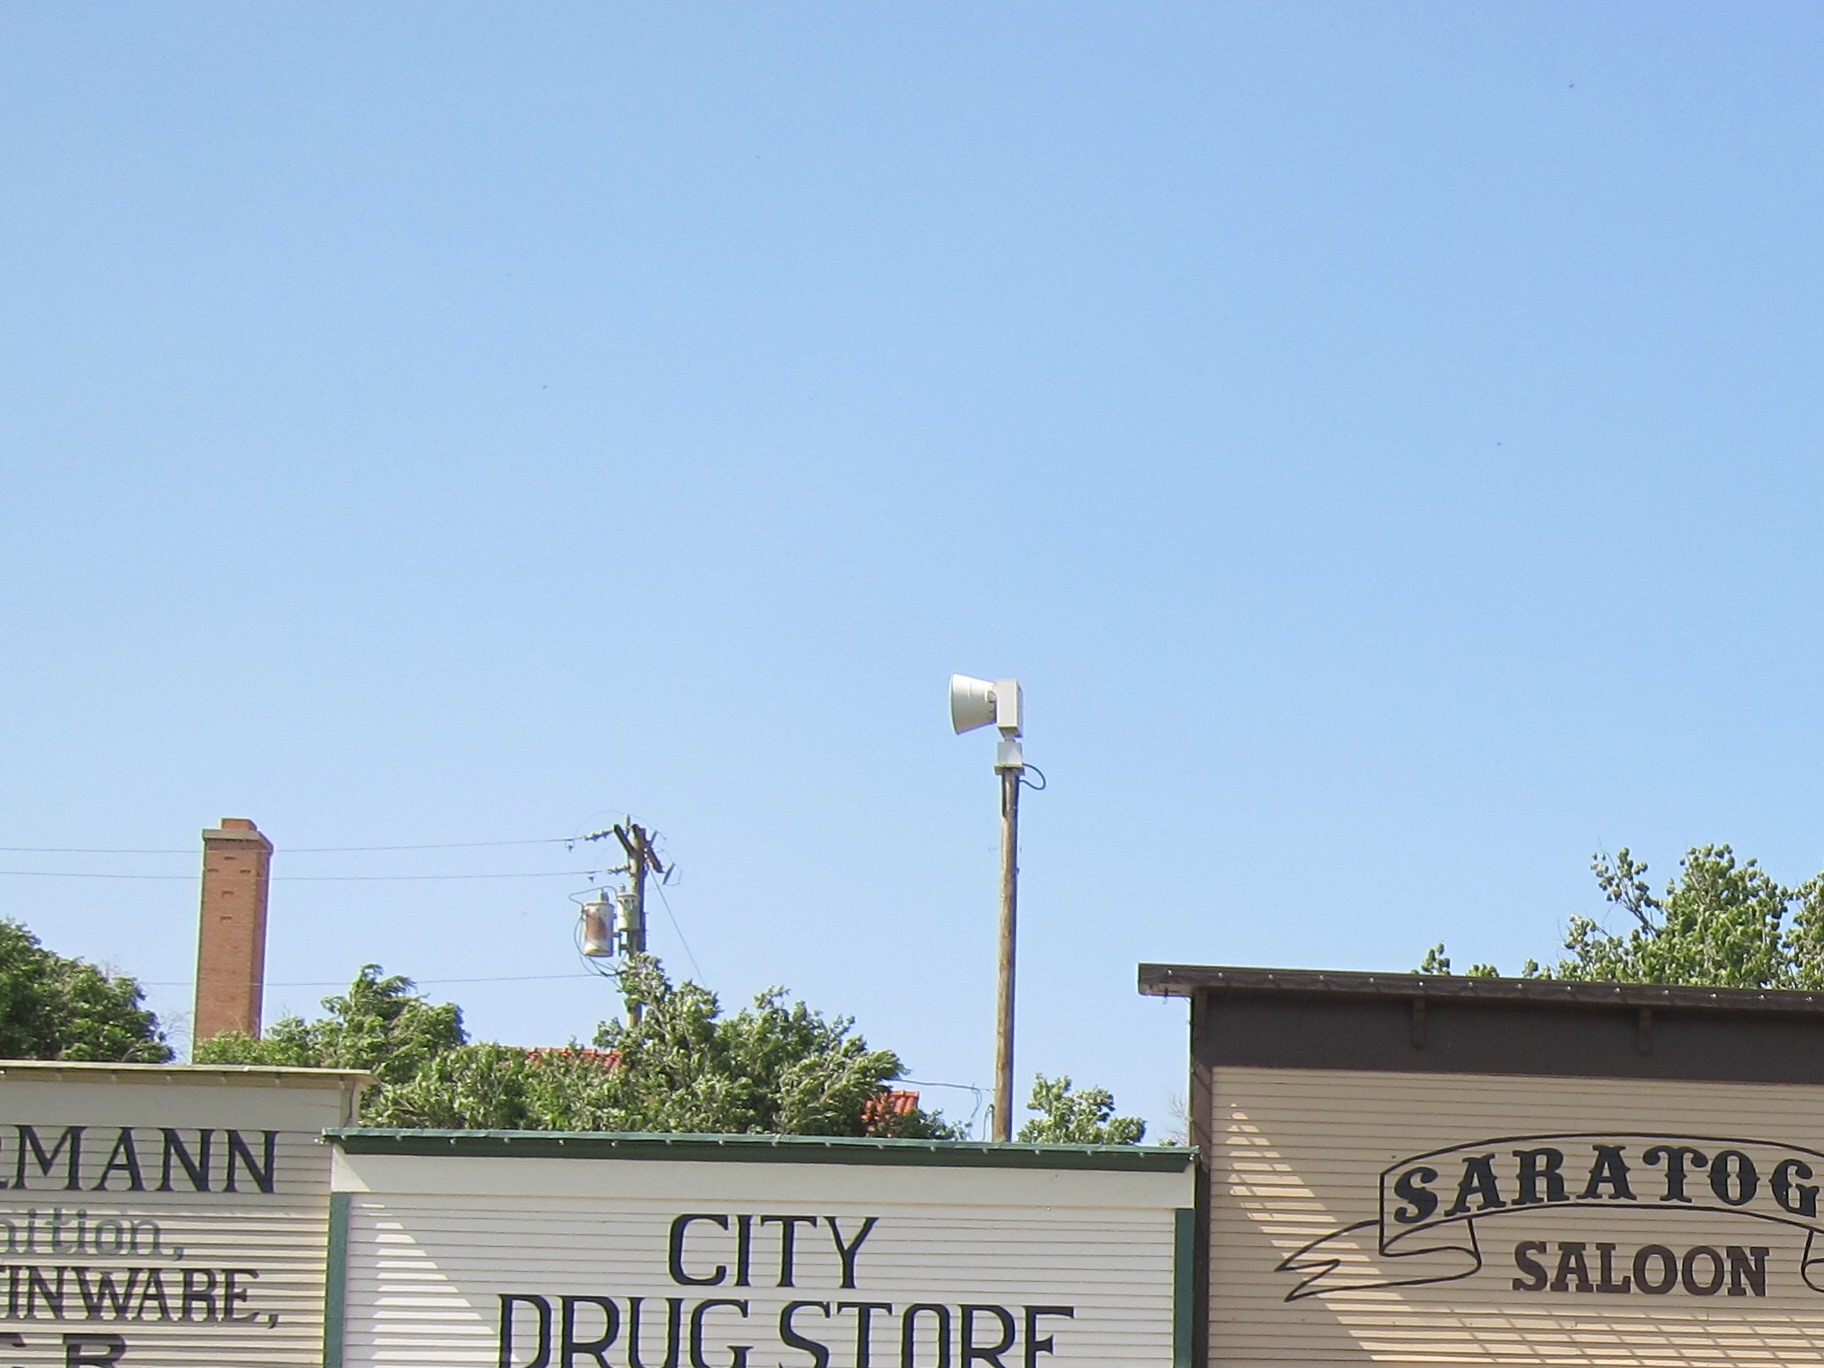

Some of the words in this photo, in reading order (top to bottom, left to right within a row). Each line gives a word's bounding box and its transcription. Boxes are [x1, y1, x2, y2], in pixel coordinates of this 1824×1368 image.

[0, 1124, 281, 1194] MANN
[668, 1213, 880, 1290] CITY
[1512, 1240, 1771, 1297] SALOON
[0, 1266, 279, 1329] INWARE,
